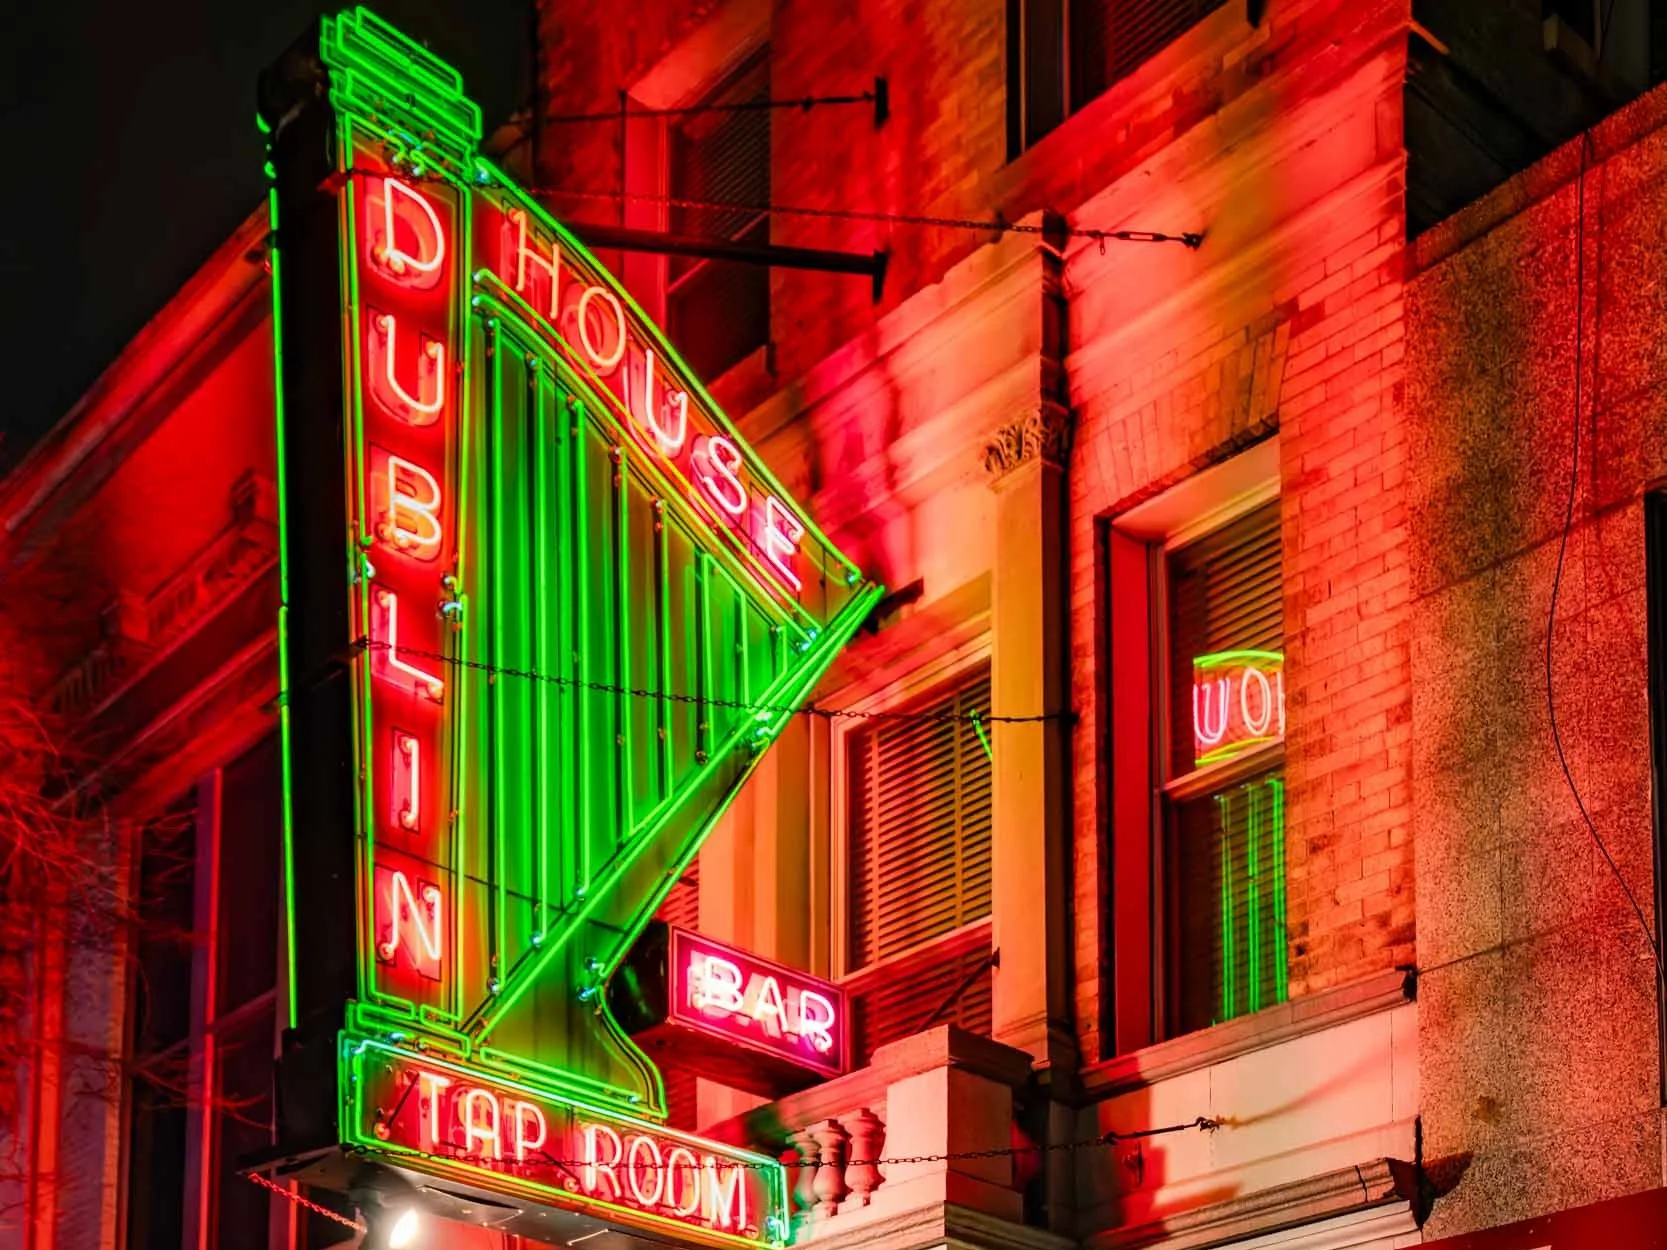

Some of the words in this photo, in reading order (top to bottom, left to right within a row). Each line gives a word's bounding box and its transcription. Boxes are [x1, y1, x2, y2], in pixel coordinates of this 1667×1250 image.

[506, 204, 803, 592] HOUSE
[368, 177, 445, 978] DUBLIN
[688, 952, 836, 1053] BAR
[412, 1069, 547, 1164] TAP
[575, 1122, 750, 1228] ROOM
